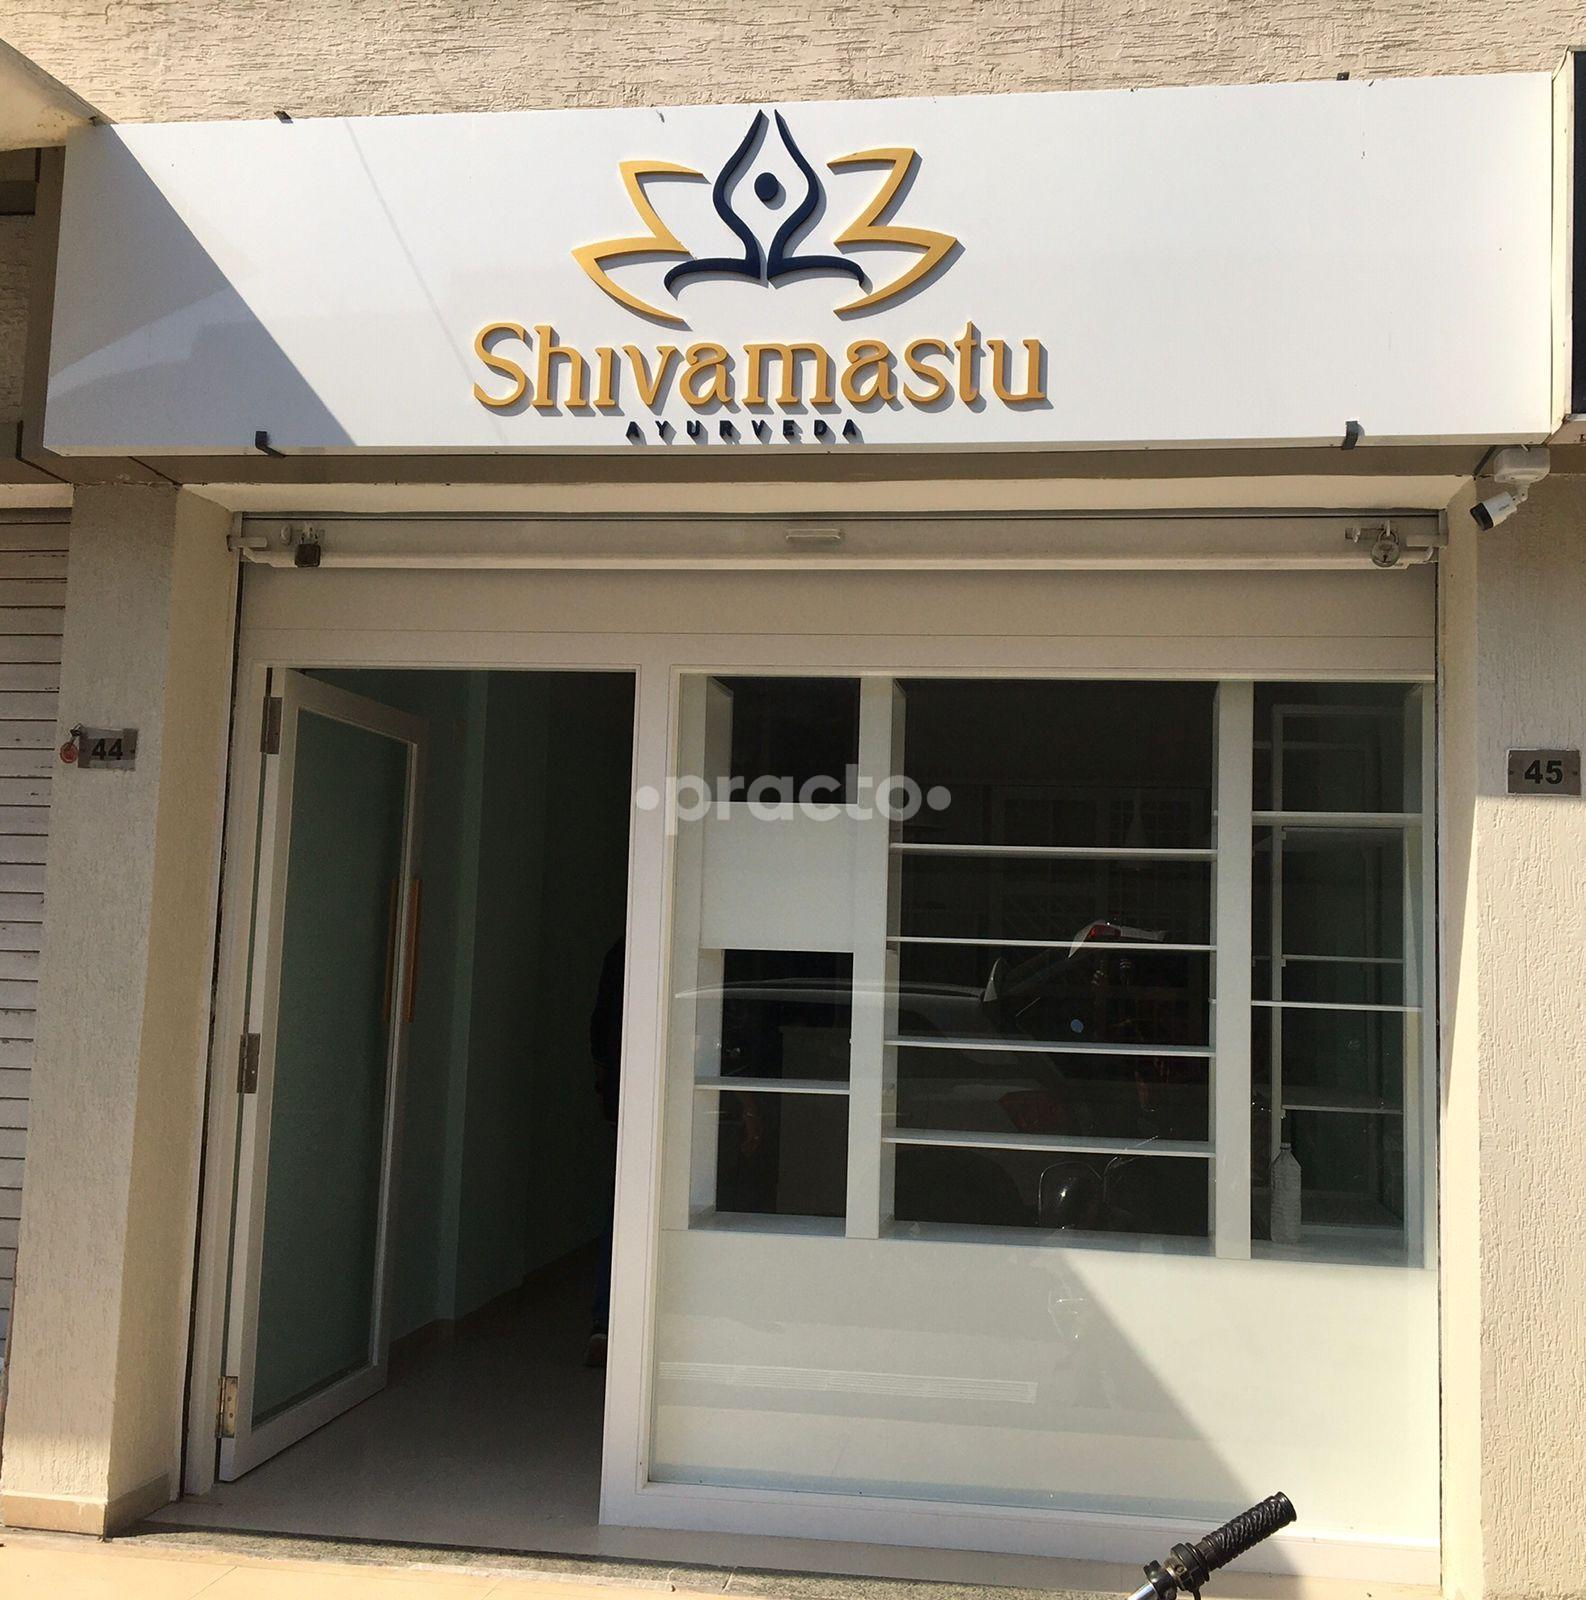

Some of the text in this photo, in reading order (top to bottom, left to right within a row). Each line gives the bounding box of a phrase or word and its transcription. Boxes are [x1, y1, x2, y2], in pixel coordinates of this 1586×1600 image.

[473, 320, 1047, 407] Shivamastu
[625, 418, 858, 438] AYURVEDA
[91, 738, 123, 761] 44
[1524, 759, 1563, 785] 45
